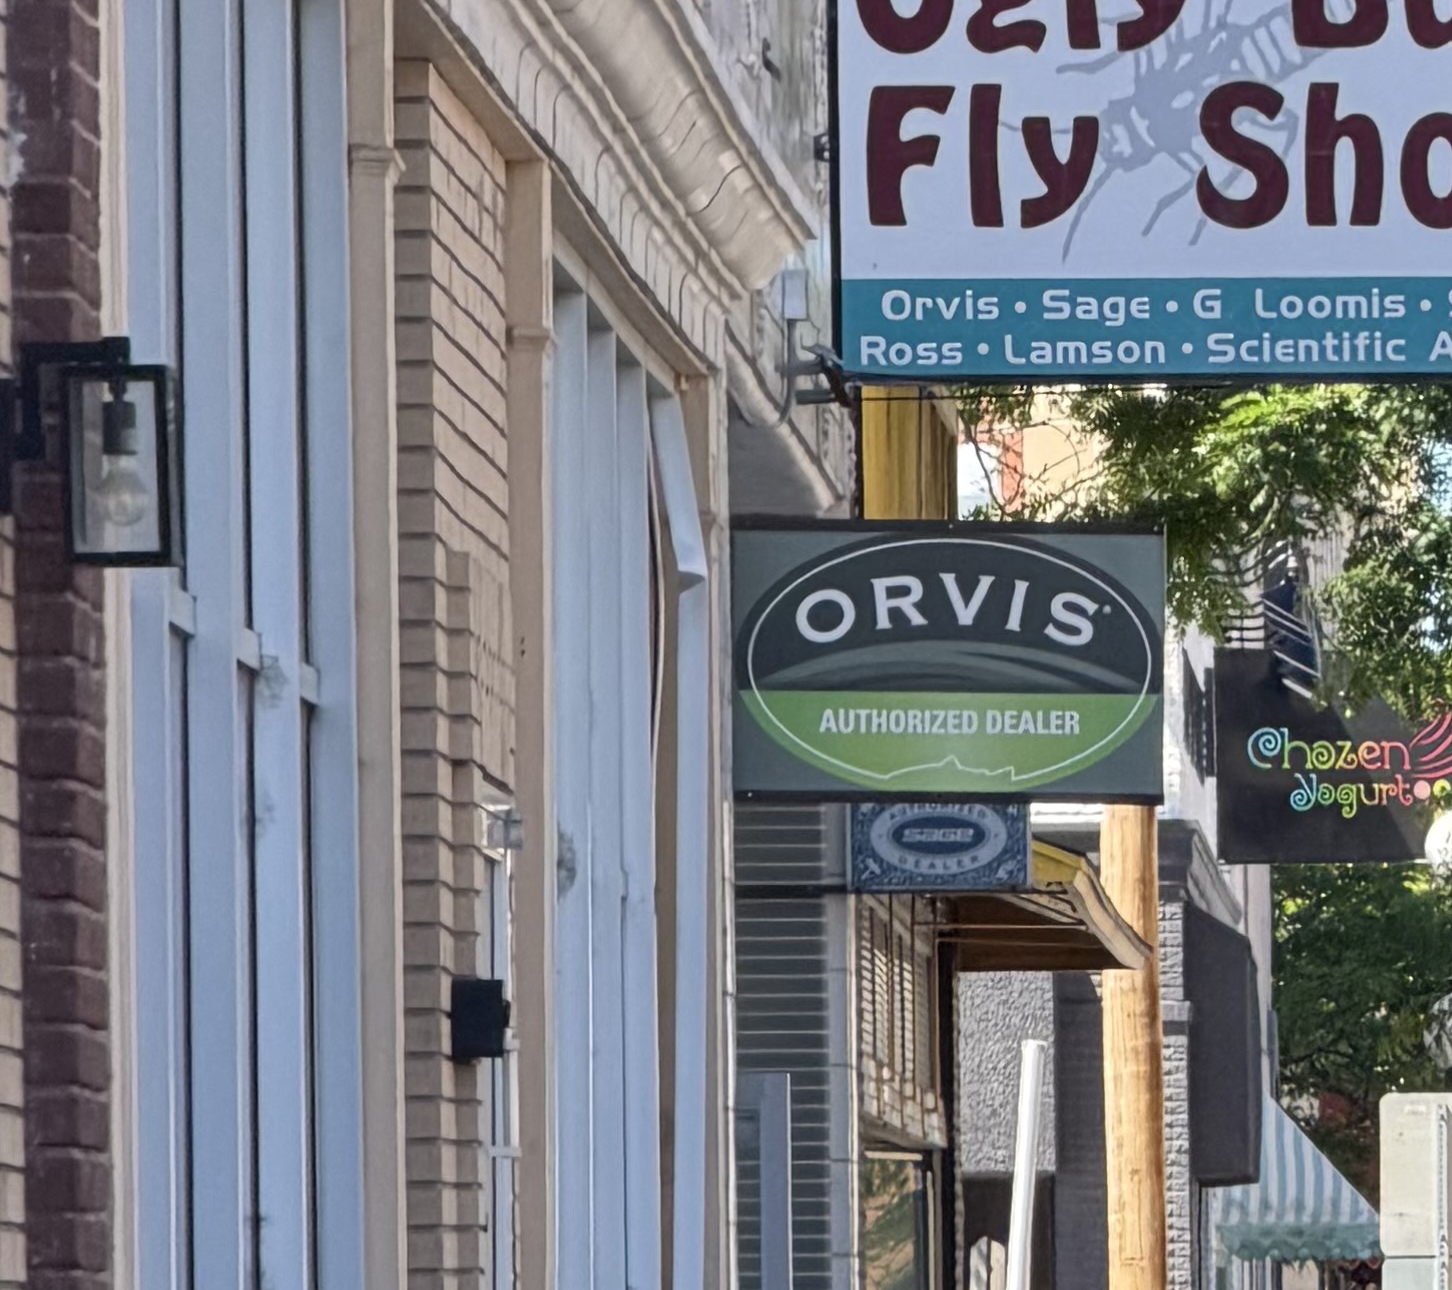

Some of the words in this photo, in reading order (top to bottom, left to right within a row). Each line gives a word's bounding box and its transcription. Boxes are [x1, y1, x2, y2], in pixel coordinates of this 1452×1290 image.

[866, 83, 1099, 228] Fly
[881, 289, 1000, 321] Orvis
[1042, 289, 1150, 327] Sage
[1193, 288, 1222, 319] G
[1255, 287, 1406, 319] Loomis
[860, 335, 963, 366] Ross
[1004, 334, 1166, 365] Lamson
[1206, 330, 1406, 364] Scientific
[796, 573, 1099, 646] ORVIS
[819, 709, 978, 735] AUTHORIZED
[985, 710, 1080, 736] DEALER
[1289, 772, 1414, 818] Yogurt
